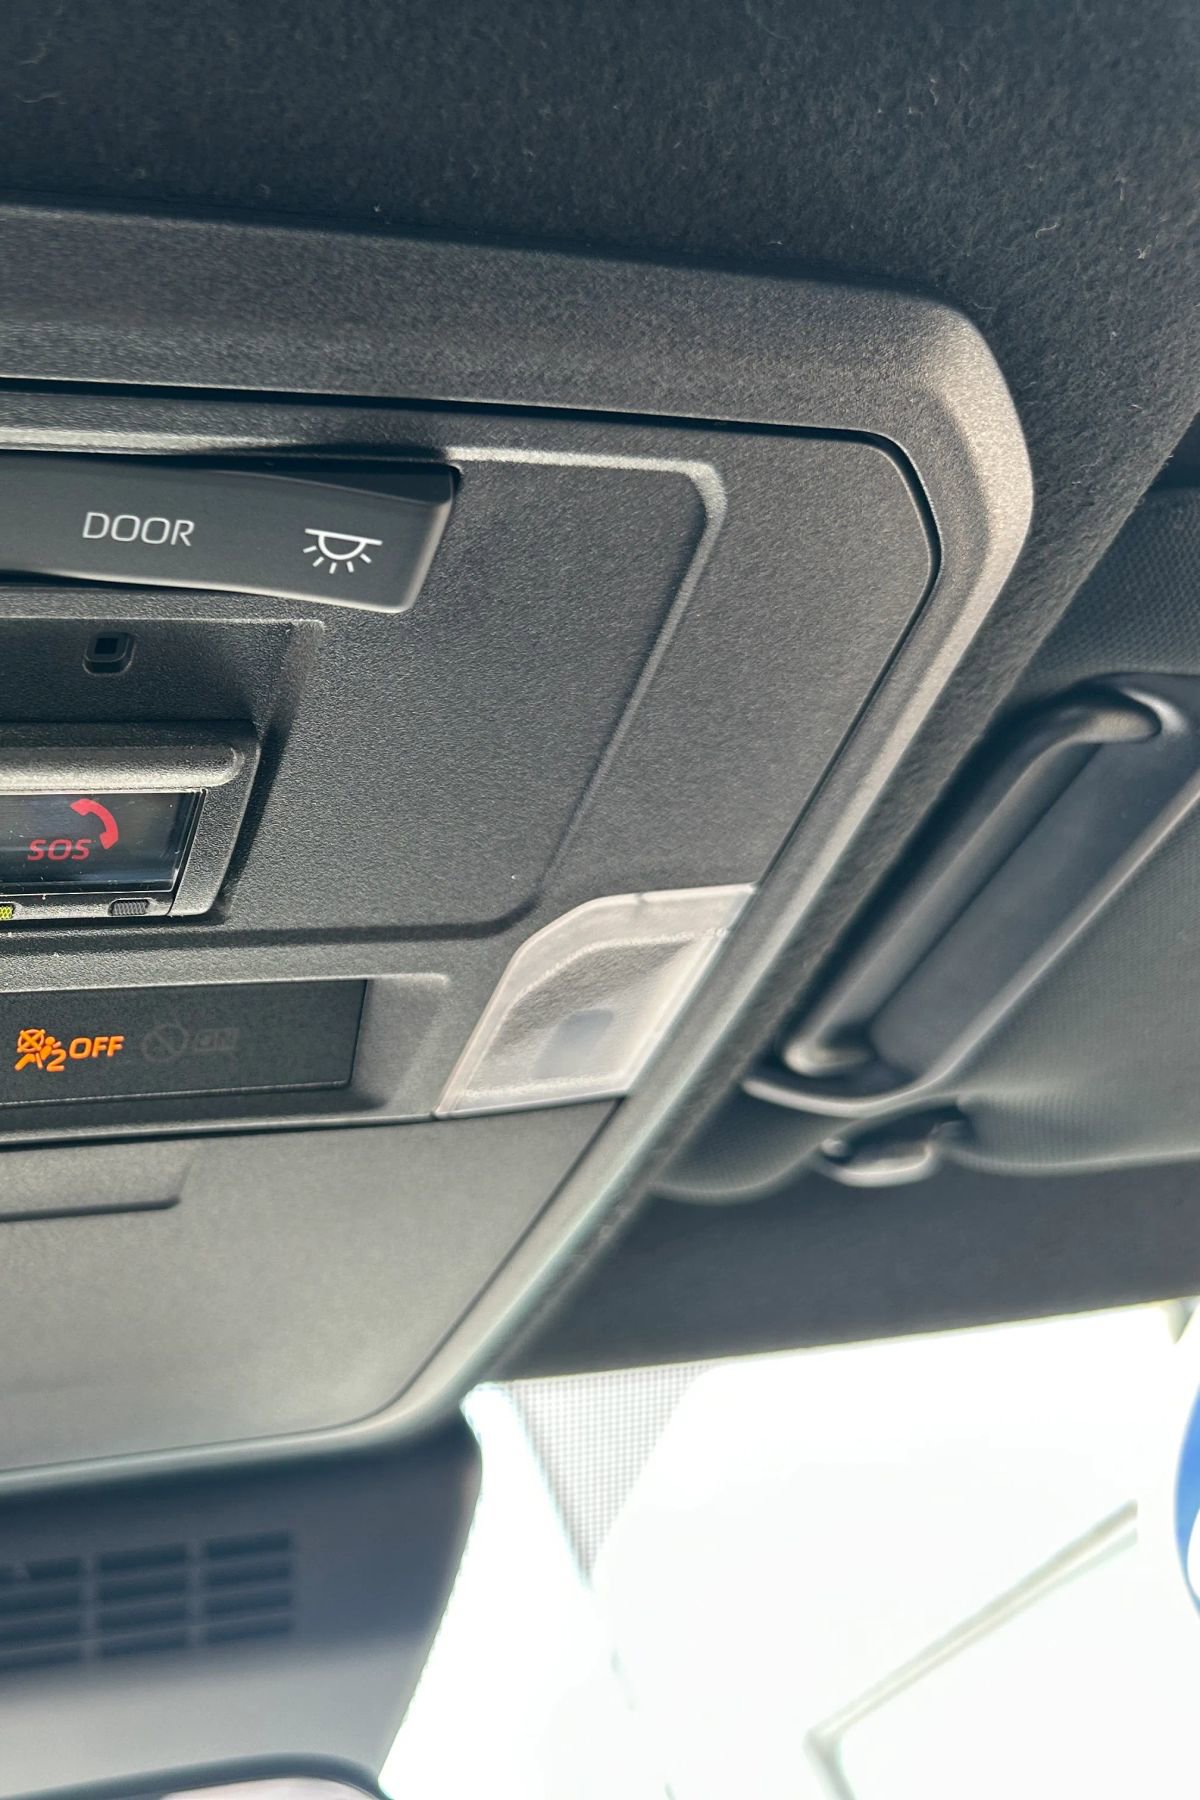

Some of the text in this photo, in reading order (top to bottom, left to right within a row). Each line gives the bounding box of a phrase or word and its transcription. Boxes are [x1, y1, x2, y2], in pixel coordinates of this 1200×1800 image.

[82, 512, 195, 547] DOOR
[27, 838, 92, 862] SOS
[69, 1035, 125, 1059] OFF
